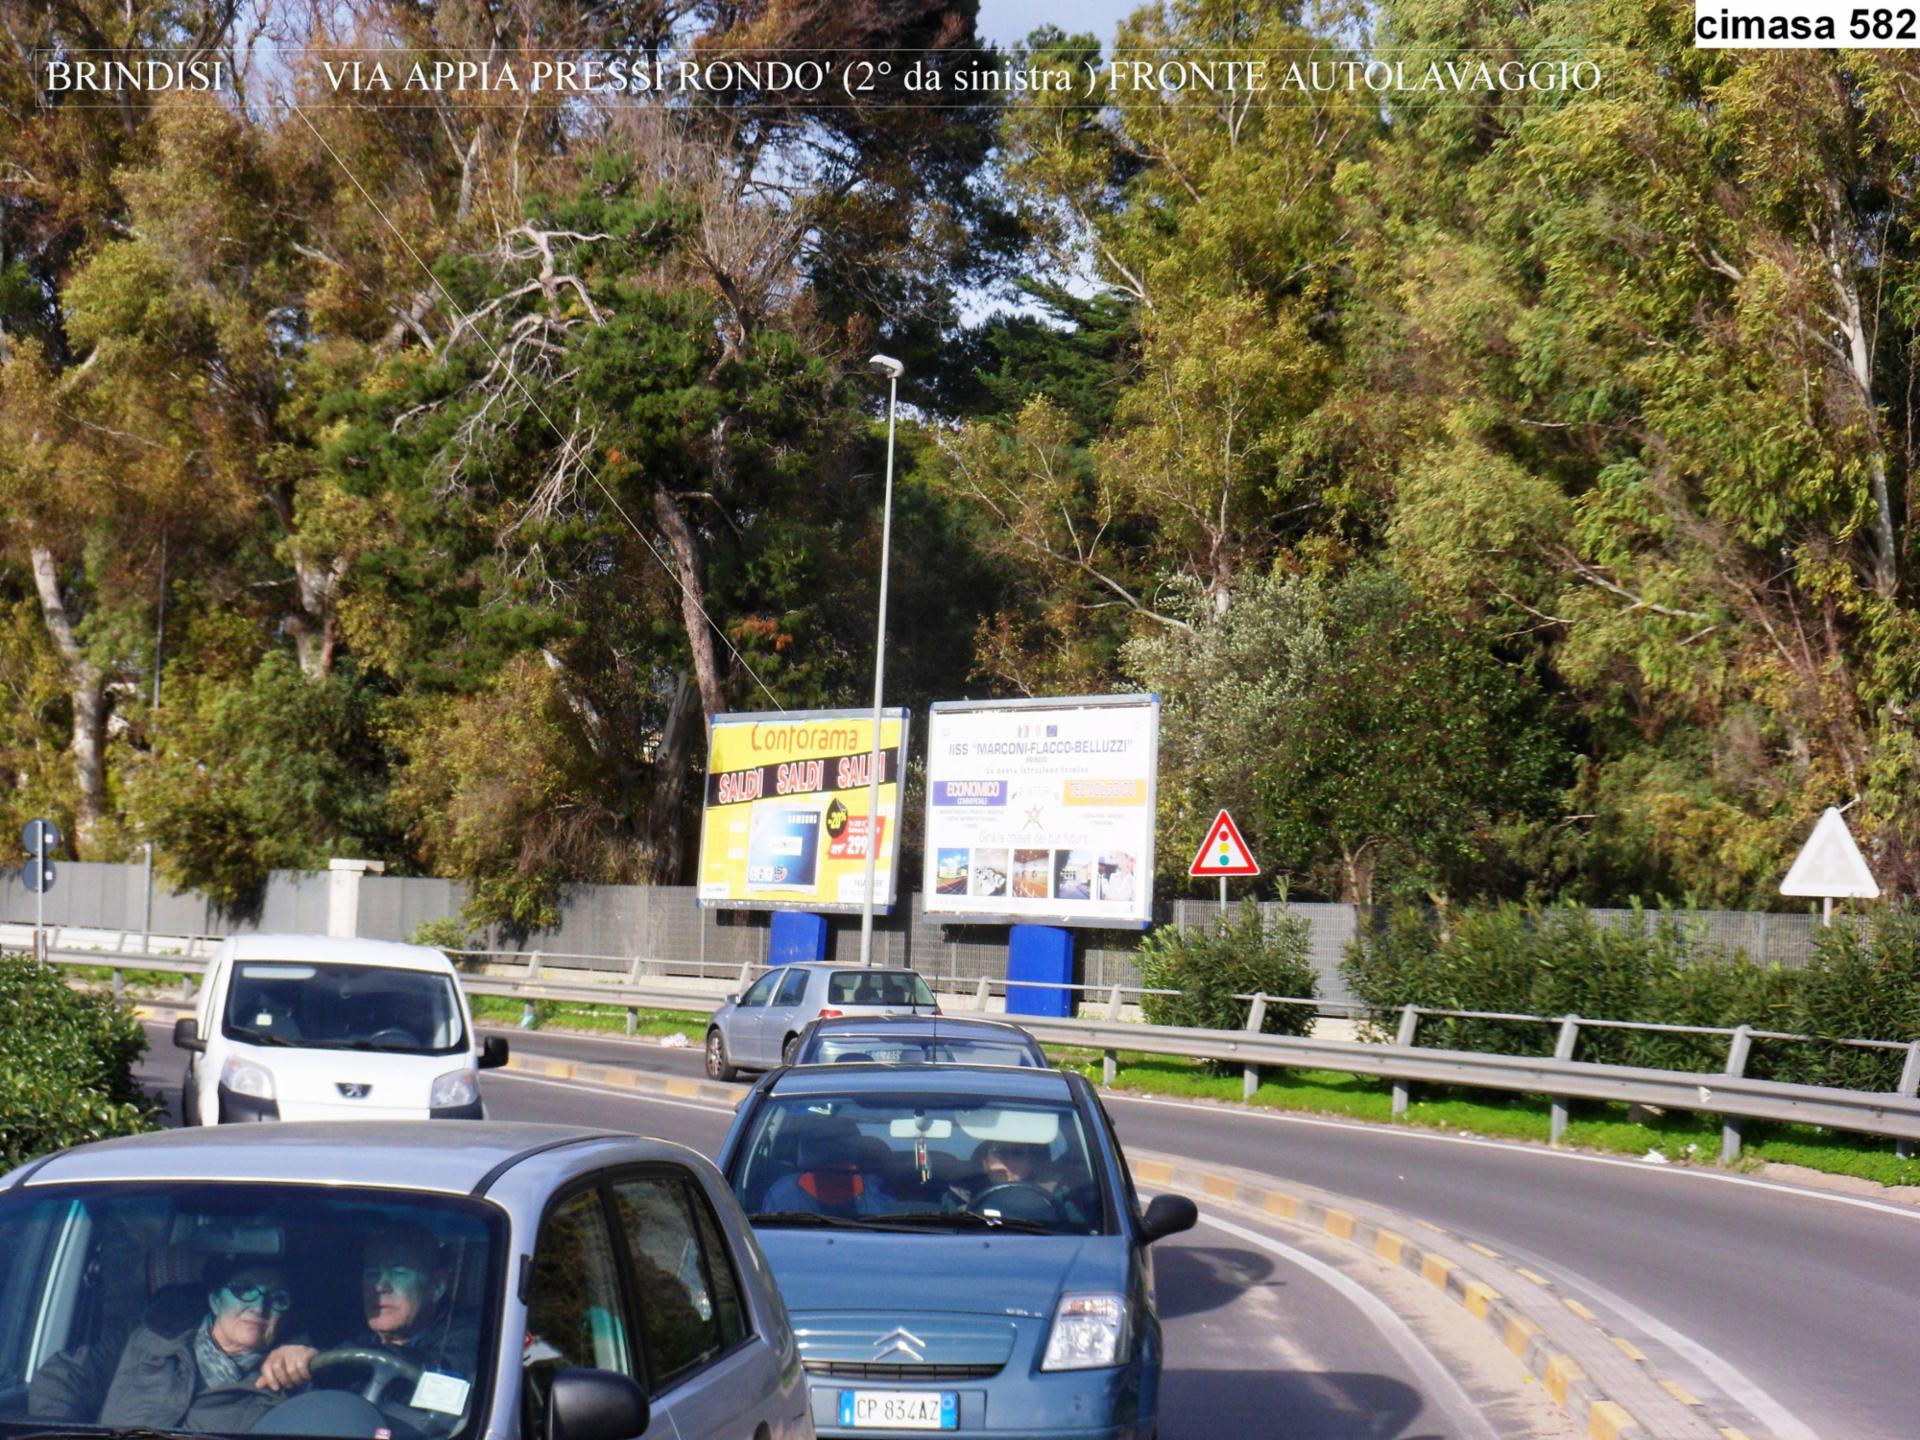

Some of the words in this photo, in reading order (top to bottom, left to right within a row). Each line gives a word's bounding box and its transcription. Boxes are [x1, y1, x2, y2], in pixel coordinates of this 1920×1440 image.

[719, 768, 764, 804] SALDI
[776, 760, 825, 795] SALDI
[947, 781, 1000, 797] ECONOMICO
[857, 1399, 878, 1419] CP
[884, 1400, 939, 1421] 834AZ
